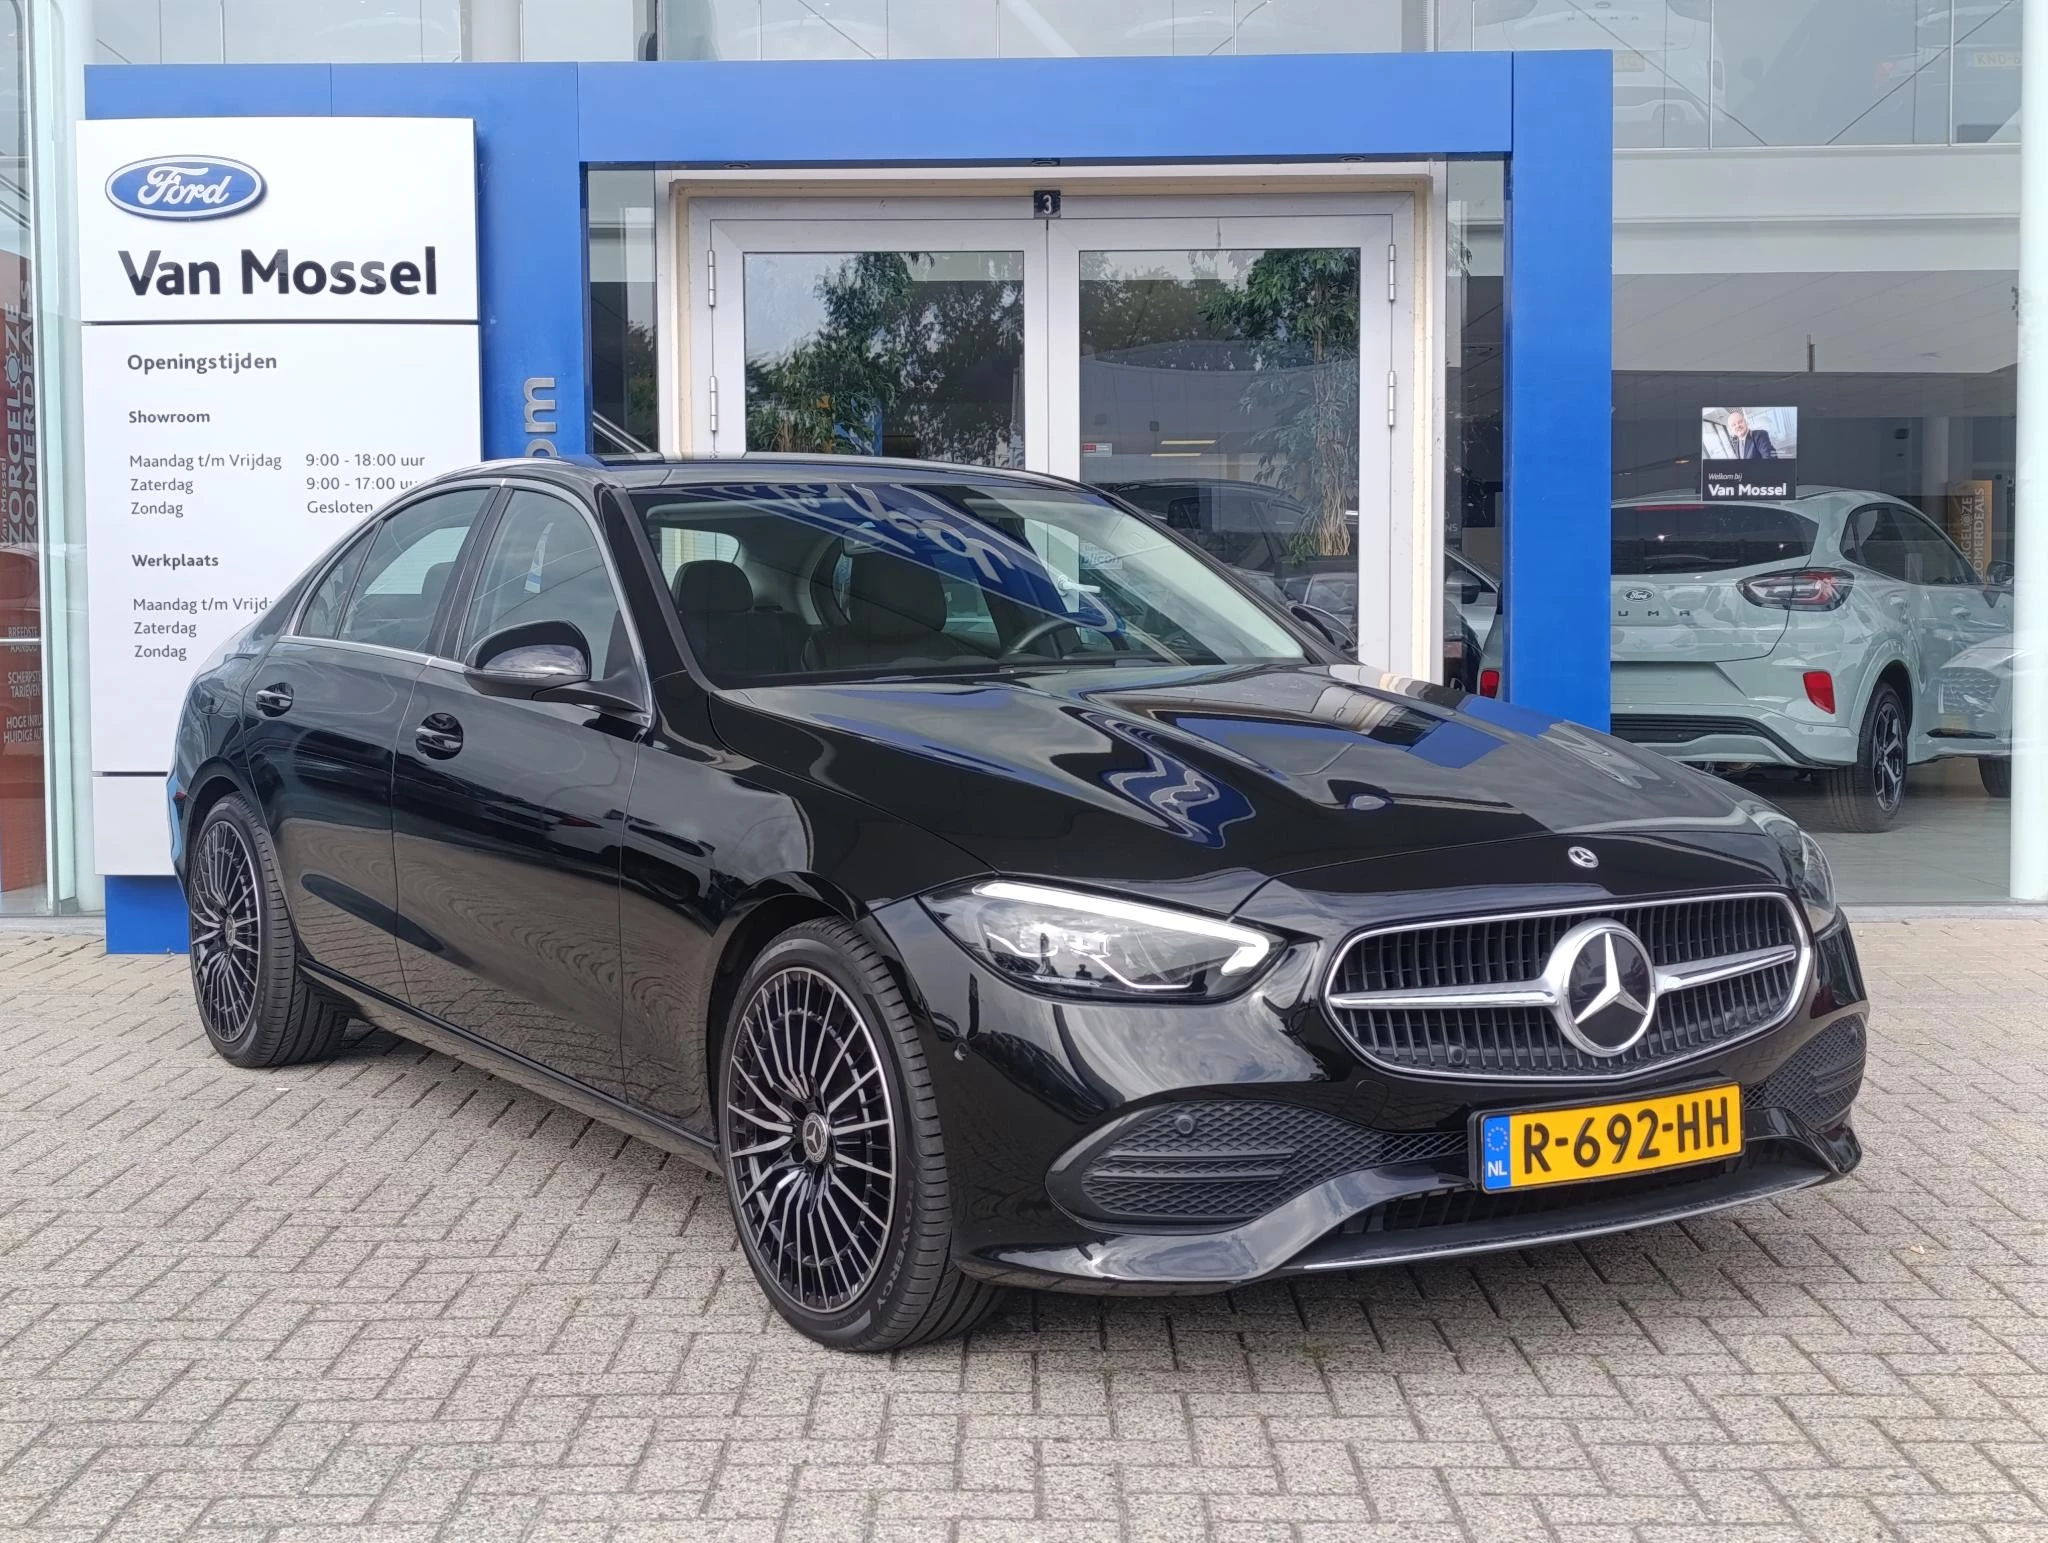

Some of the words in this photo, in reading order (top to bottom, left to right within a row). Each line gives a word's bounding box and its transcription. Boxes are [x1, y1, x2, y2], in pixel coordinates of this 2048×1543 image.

[137, 166, 233, 205] Ford
[1042, 194, 1052, 215] 3
[117, 249, 221, 296] Van
[240, 246, 437, 295] Mossel
[127, 352, 278, 375] Openingstijden
[128, 410, 211, 424] Showroom
[129, 453, 194, 471] Maandag
[198, 453, 225, 467] t/m
[229, 453, 282, 471] Vrijdag
[305, 453, 340, 467] 9:00
[354, 453, 396, 467] 18:00
[400, 456, 426, 467] uur
[0, 457, 8, 512] Mossel
[130, 477, 194, 495] Zaterdag
[306, 477, 340, 490] 9:00
[354, 477, 396, 490] 17:00
[1707, 483, 1735, 497] Van
[1738, 483, 1787, 496] Mossel
[130, 501, 184, 518] Zondag
[307, 499, 374, 514] Gesloten
[131, 553, 219, 570] Werkplaats
[133, 597, 197, 614] Maandag
[201, 597, 228, 611] t/m
[232, 597, 273, 614] Vrijd
[133, 621, 197, 638] Zaterdag
[134, 645, 187, 662] Zondag
[6, 716, 27, 729] HOGE
[3, 729, 32, 744] HUIDIGE
[1523, 1097, 1729, 1175] R-692-HH
[1487, 1160, 1507, 1177] NL
